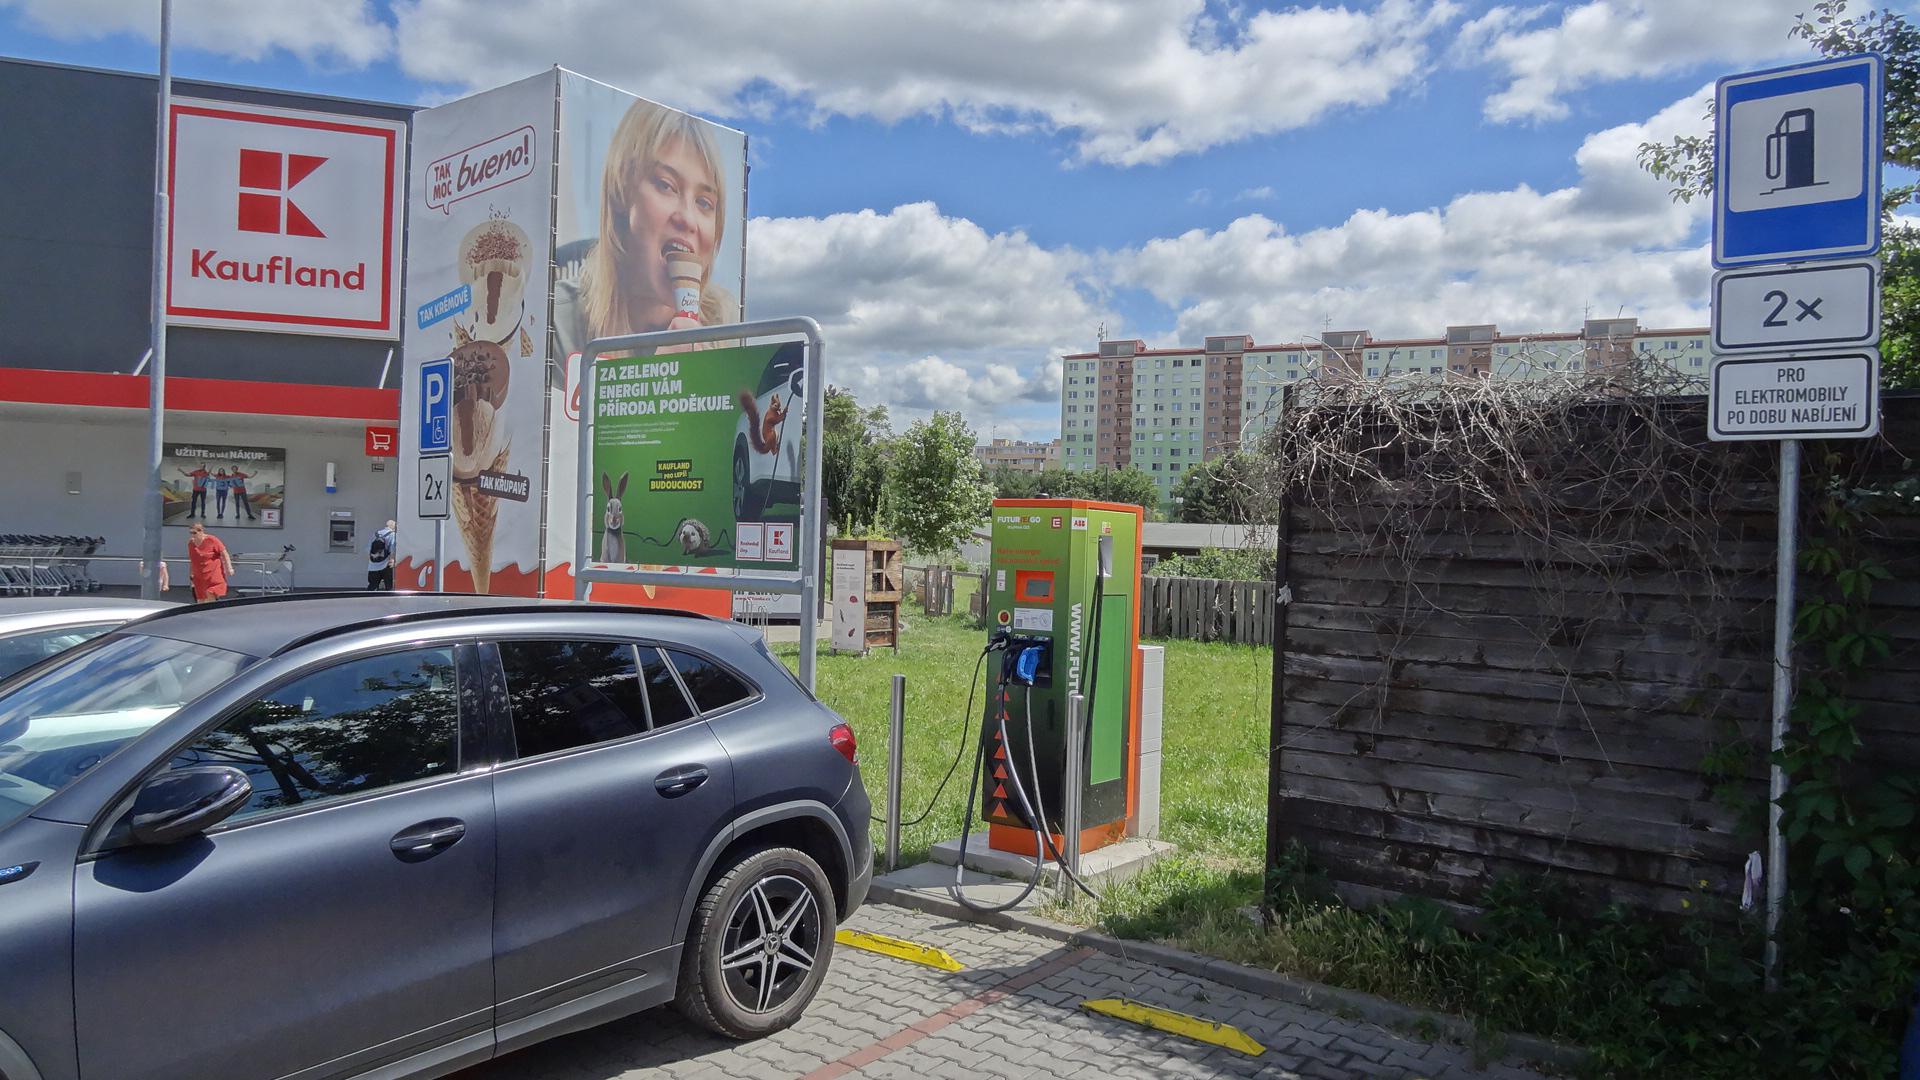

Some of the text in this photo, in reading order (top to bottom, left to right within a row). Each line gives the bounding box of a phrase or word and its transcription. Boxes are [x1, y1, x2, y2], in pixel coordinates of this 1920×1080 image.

[434, 162, 451, 182] TAK
[457, 134, 529, 192] bueno!
[433, 180, 452, 201] MOC
[191, 248, 365, 291] Kaufland
[419, 286, 469, 323] TAK KRÉMOVÉ
[600, 361, 679, 382] ZA ZELENOU
[1777, 367, 1805, 383] PRO
[426, 373, 444, 424] P
[599, 382, 649, 400] ENERGII
[652, 377, 682, 396] VÁM
[1735, 386, 1848, 405] ELEKTROMOBILY
[598, 393, 734, 417] PŘÍRODA PODĚKUJE.
[1727, 403, 1857, 425] PO DOBU NABÍJENÍ
[658, 462, 690, 471] KAUFLAND
[424, 473, 443, 501] 2x
[480, 475, 527, 496] TAK KŘUPAVÉ
[650, 480, 703, 490] BUDOUCNOST
